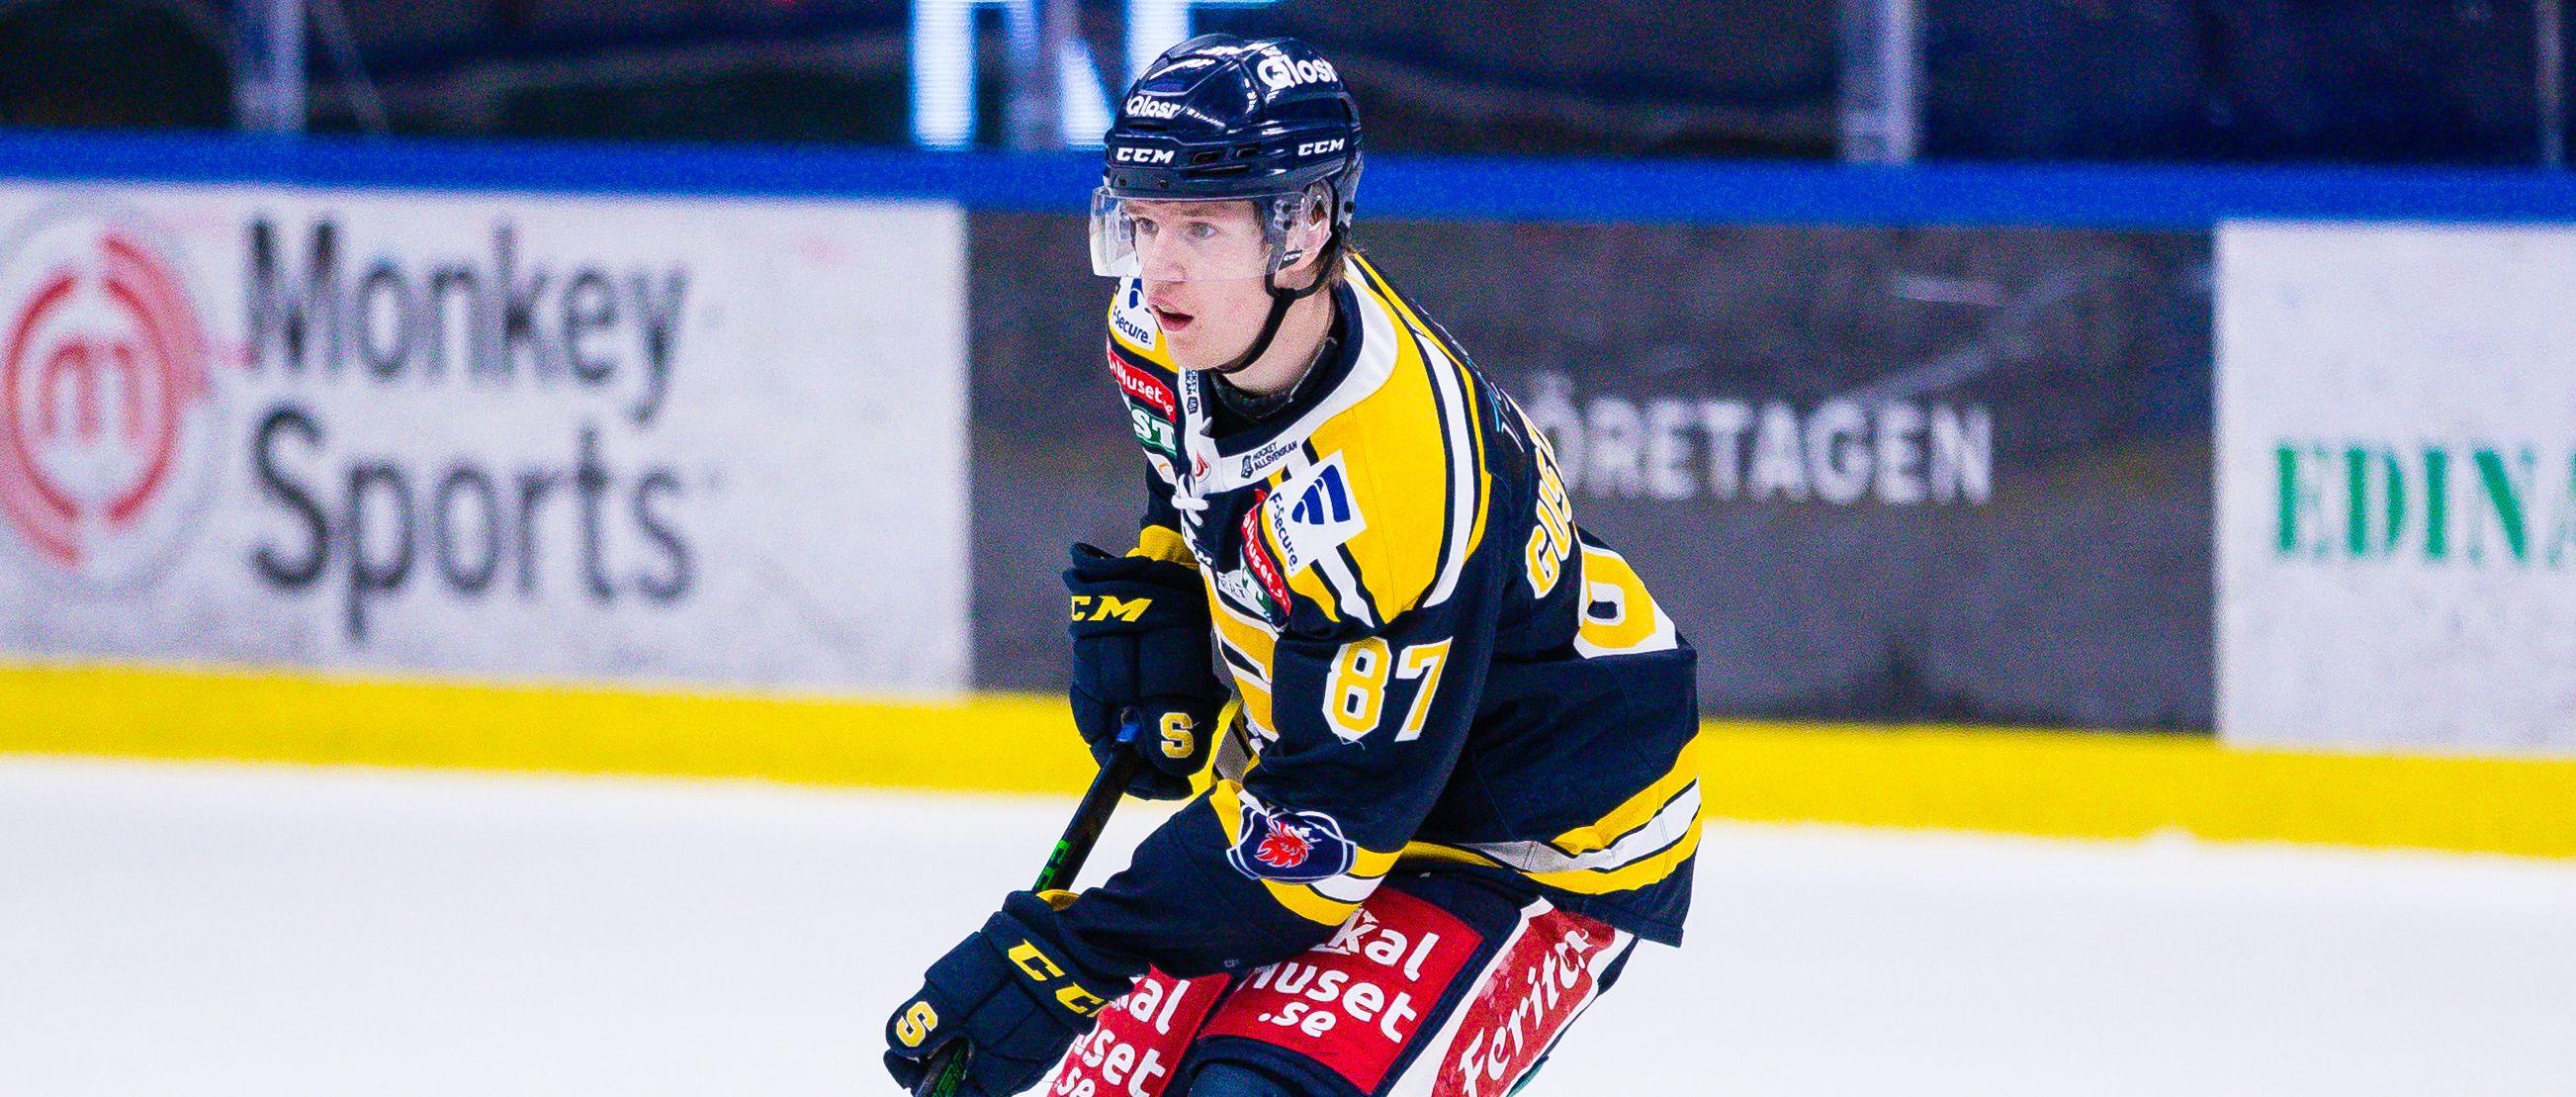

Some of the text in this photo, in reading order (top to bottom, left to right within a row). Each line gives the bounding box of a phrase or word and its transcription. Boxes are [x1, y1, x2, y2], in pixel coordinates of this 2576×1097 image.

[1115, 147, 1175, 163] CCM
[1297, 138, 1345, 156] CCM
[247, 220, 689, 423] Monkey
[248, 404, 695, 643] Sports
[1071, 595, 1153, 622] CM
[1323, 635, 1453, 743] 87
[1159, 712, 1195, 759] S
[1008, 939, 1110, 1018] CC
[896, 1000, 938, 1048] S
[1258, 1001, 1337, 1038] .se
